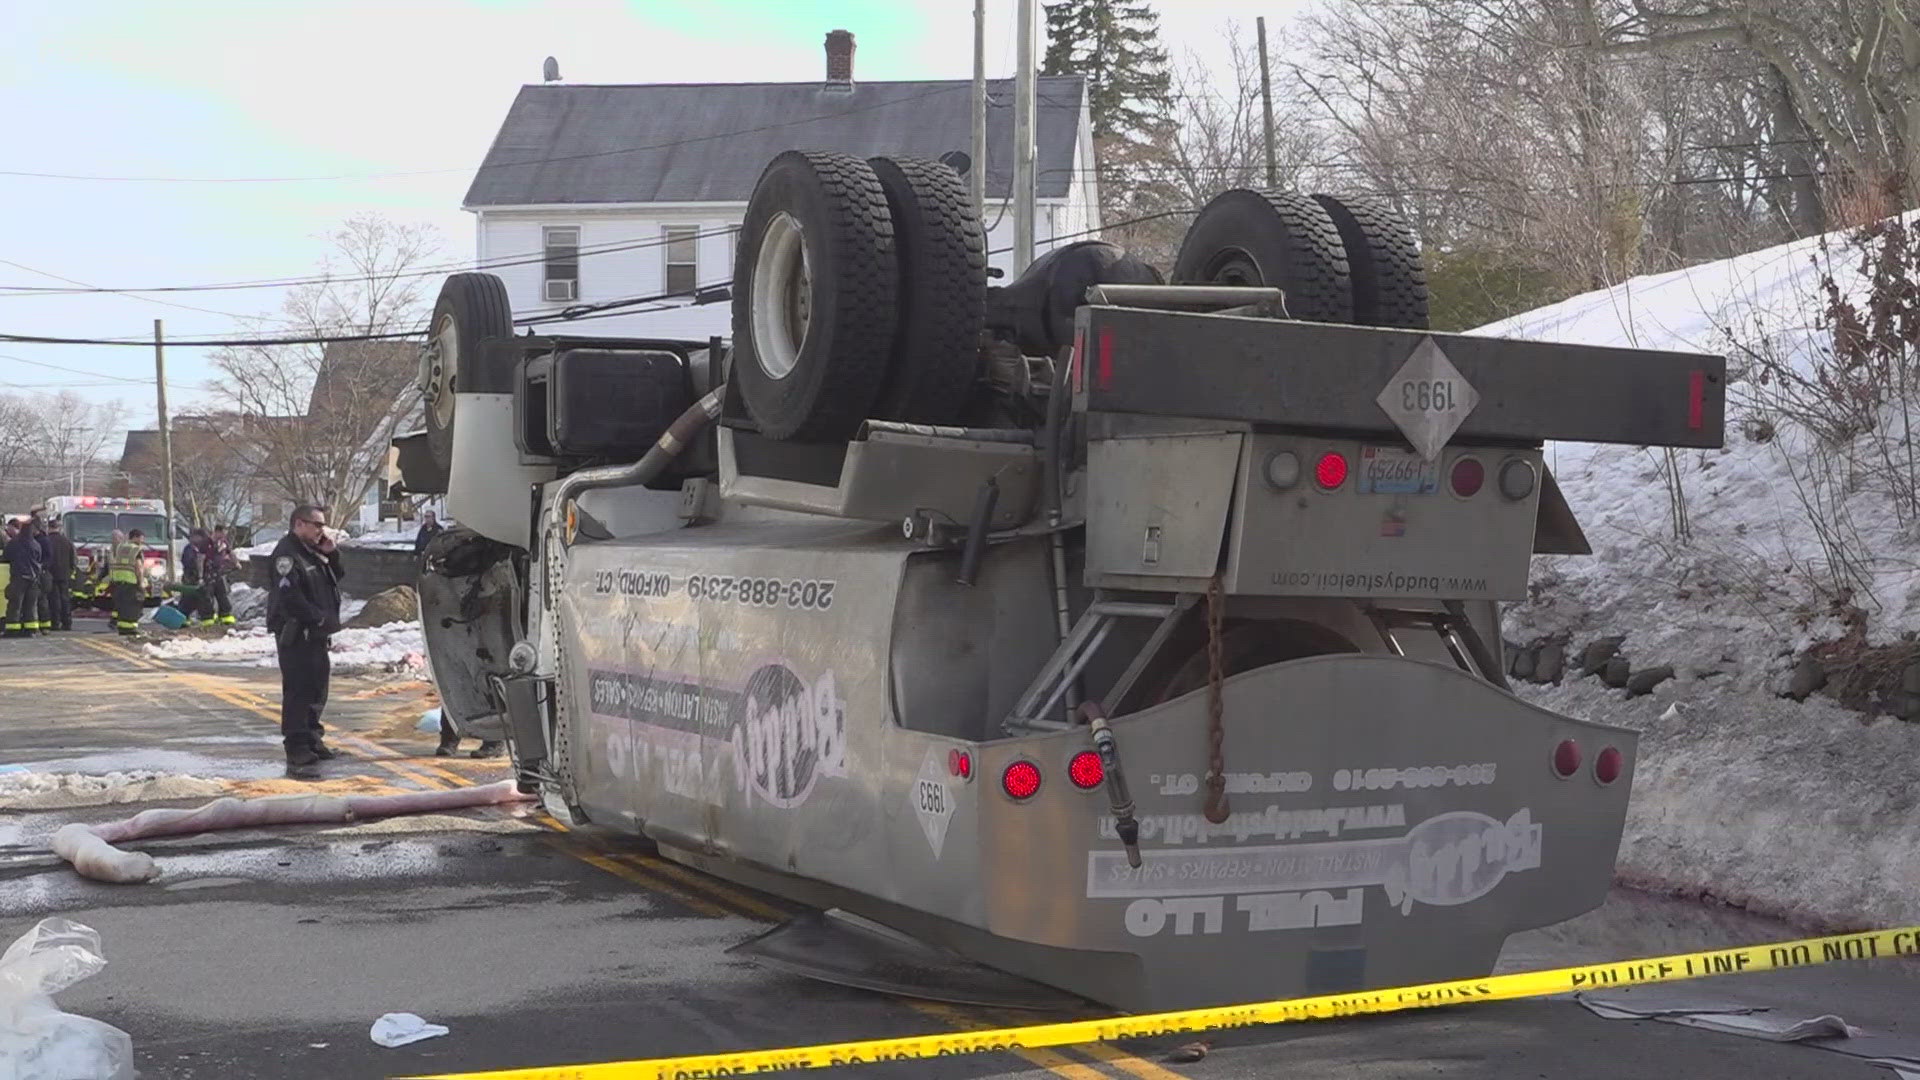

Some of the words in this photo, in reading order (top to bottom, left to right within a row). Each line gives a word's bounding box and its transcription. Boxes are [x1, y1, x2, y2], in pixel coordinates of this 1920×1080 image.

[1402, 380, 1456, 412] 1993
[594, 570, 615, 595] CT.
[616, 567, 672, 599] OXFORD,
[687, 574, 836, 611] 203-888-2319
[1270, 571, 1487, 592] www.buddysfueloil.com
[594, 679, 622, 705] SALES
[919, 780, 945, 814] 1993
[1098, 803, 1406, 845] www.buddysfueloil.cm
[1108, 862, 1166, 882] SALES
[1180, 859, 1252, 881] REPAIRS
[1236, 887, 1364, 932] FUEL
[1822, 936, 1881, 962] NOT
